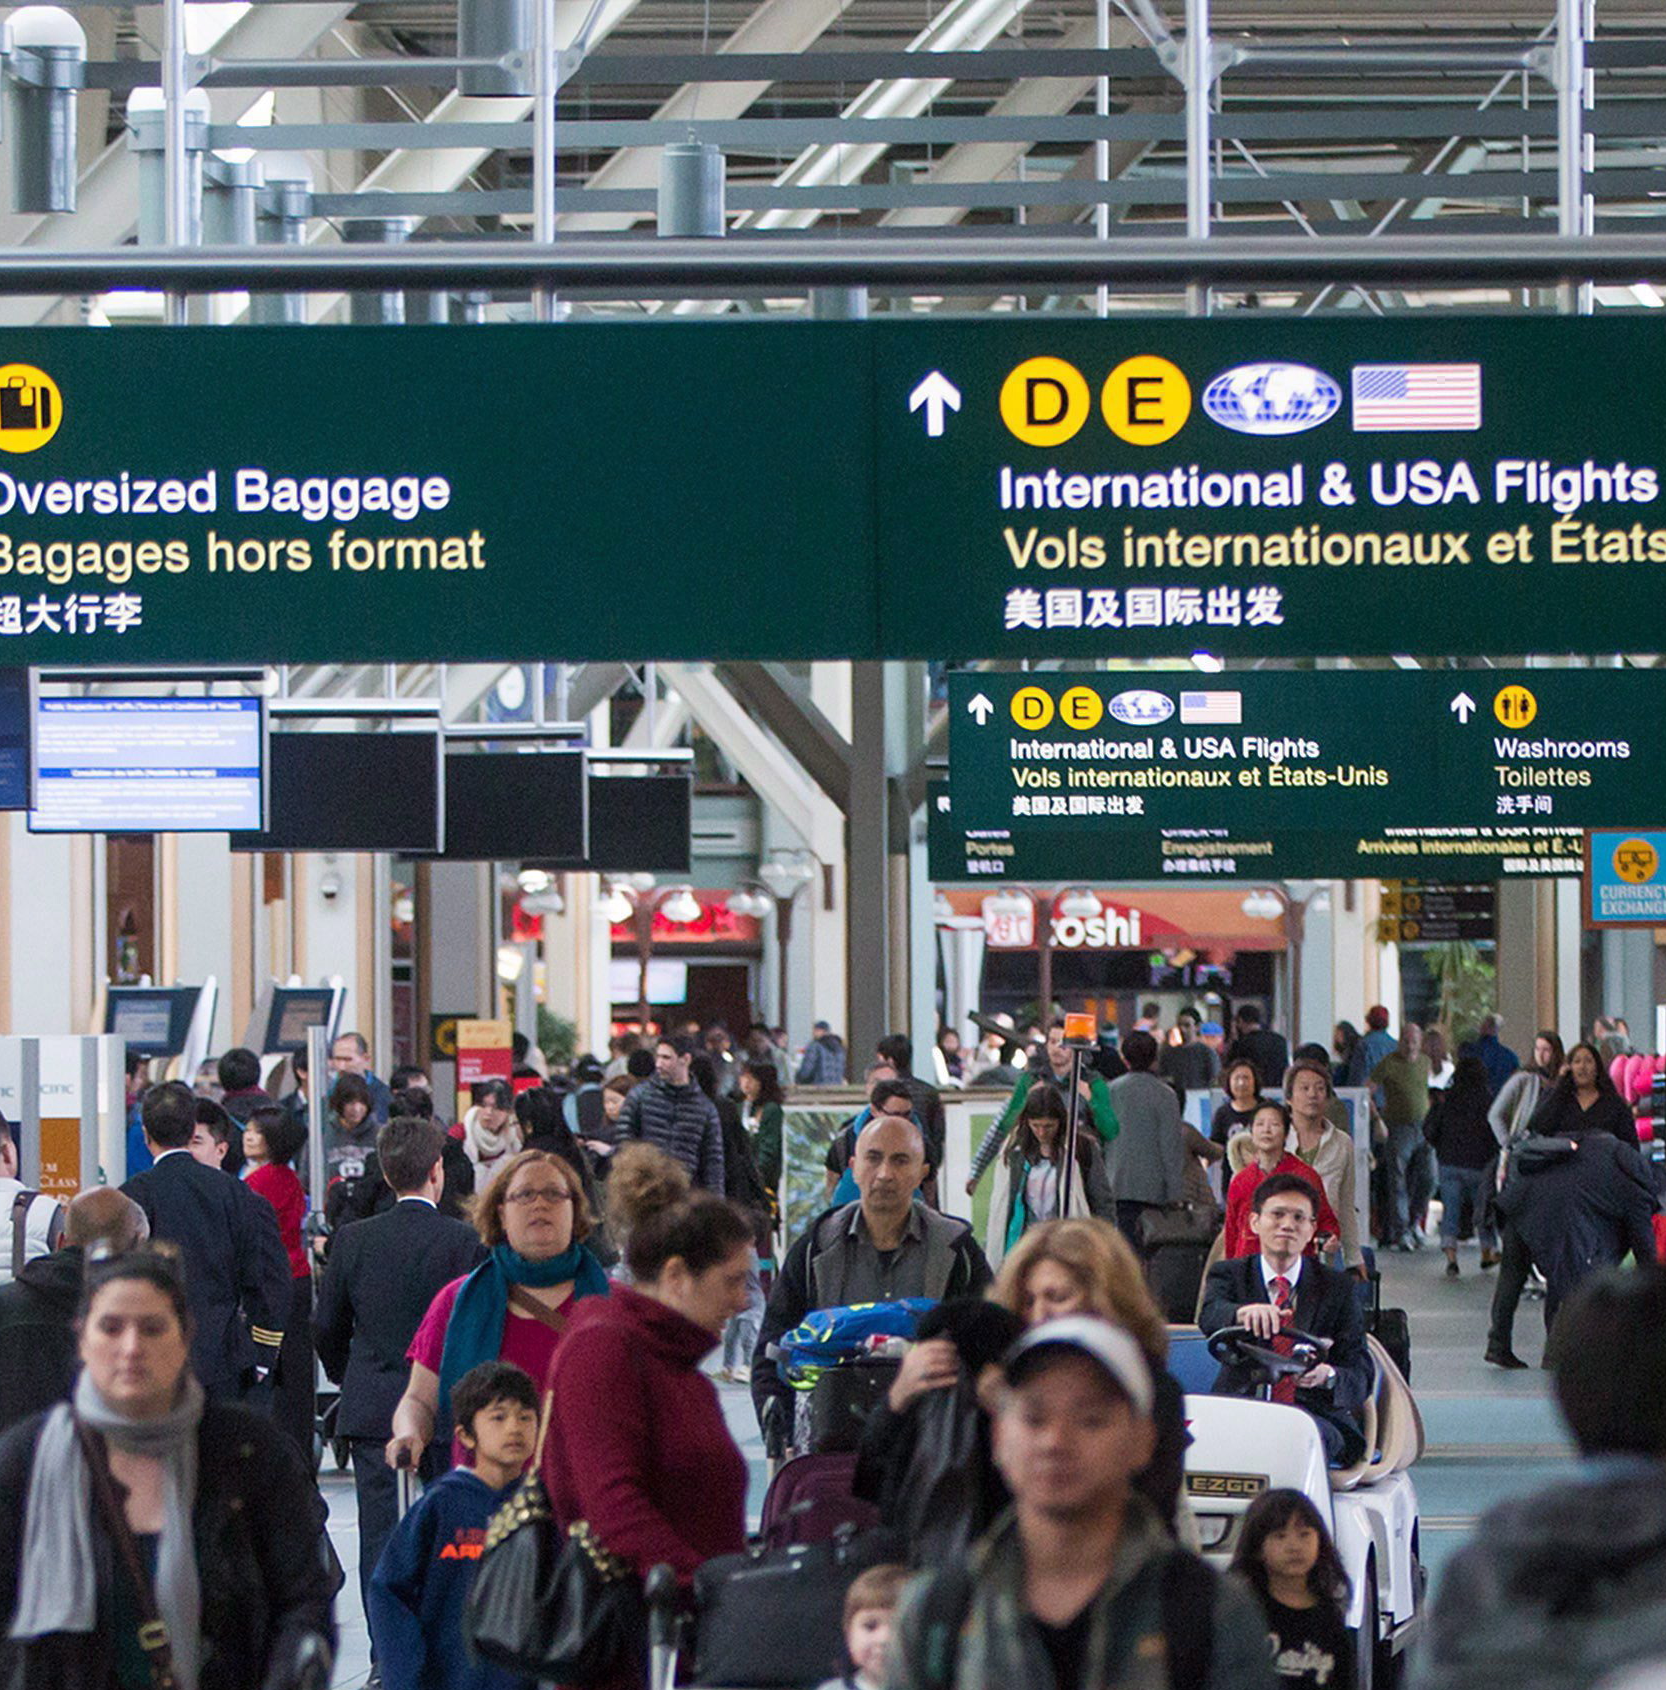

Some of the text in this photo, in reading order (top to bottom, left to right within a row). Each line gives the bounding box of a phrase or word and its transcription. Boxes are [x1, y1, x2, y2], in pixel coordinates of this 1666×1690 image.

[1024, 376, 1165, 427] D E
[235, 467, 451, 522] Baggage
[1000, 459, 1659, 513] International & USA Flights
[207, 529, 313, 574] hors
[327, 527, 486, 573] format
[1003, 527, 1107, 570] Vols
[1123, 522, 1471, 569] internationaux
[1486, 526, 1534, 565] et
[1004, 586, 1285, 630] 美国及国际出发
[1023, 696, 1090, 720] D E
[1010, 736, 1320, 763] International & USA Flights
[1494, 737, 1631, 759] Washrooms
[1011, 762, 1389, 789] Vols internationaux et États-Unis
[1494, 765, 1592, 787] Toilettes
[1012, 795, 1145, 816] 美国及国际出发
[1495, 794, 1553, 815] 洗手间
[965, 841, 1016, 857] Portes
[1161, 841, 1274, 858] Enregistrement
